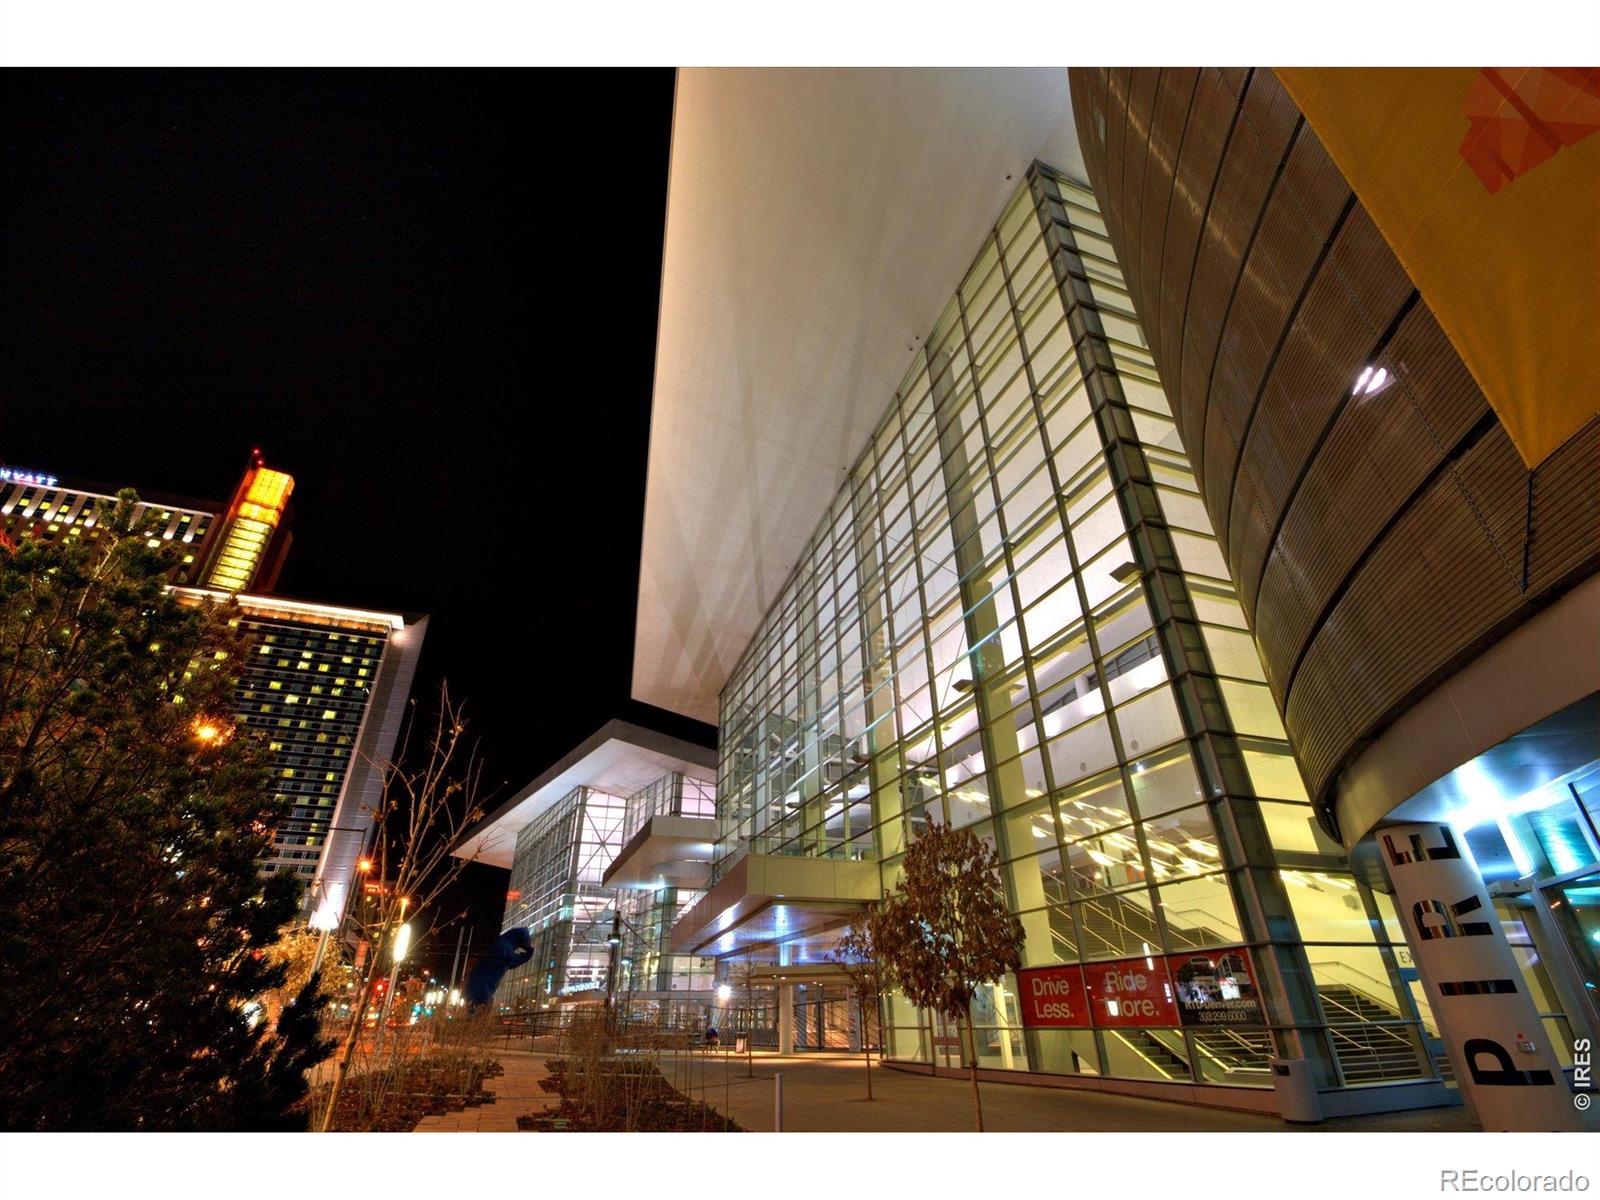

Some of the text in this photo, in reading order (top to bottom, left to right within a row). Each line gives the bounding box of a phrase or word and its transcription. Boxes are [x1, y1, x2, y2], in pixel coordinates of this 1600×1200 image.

[0, 467, 58, 486] HYATT
[1382, 825, 1556, 1086] PIRE
[1032, 976, 1070, 997] Drive
[1105, 970, 1148, 993] Ride
[1034, 999, 1075, 1019] Less.
